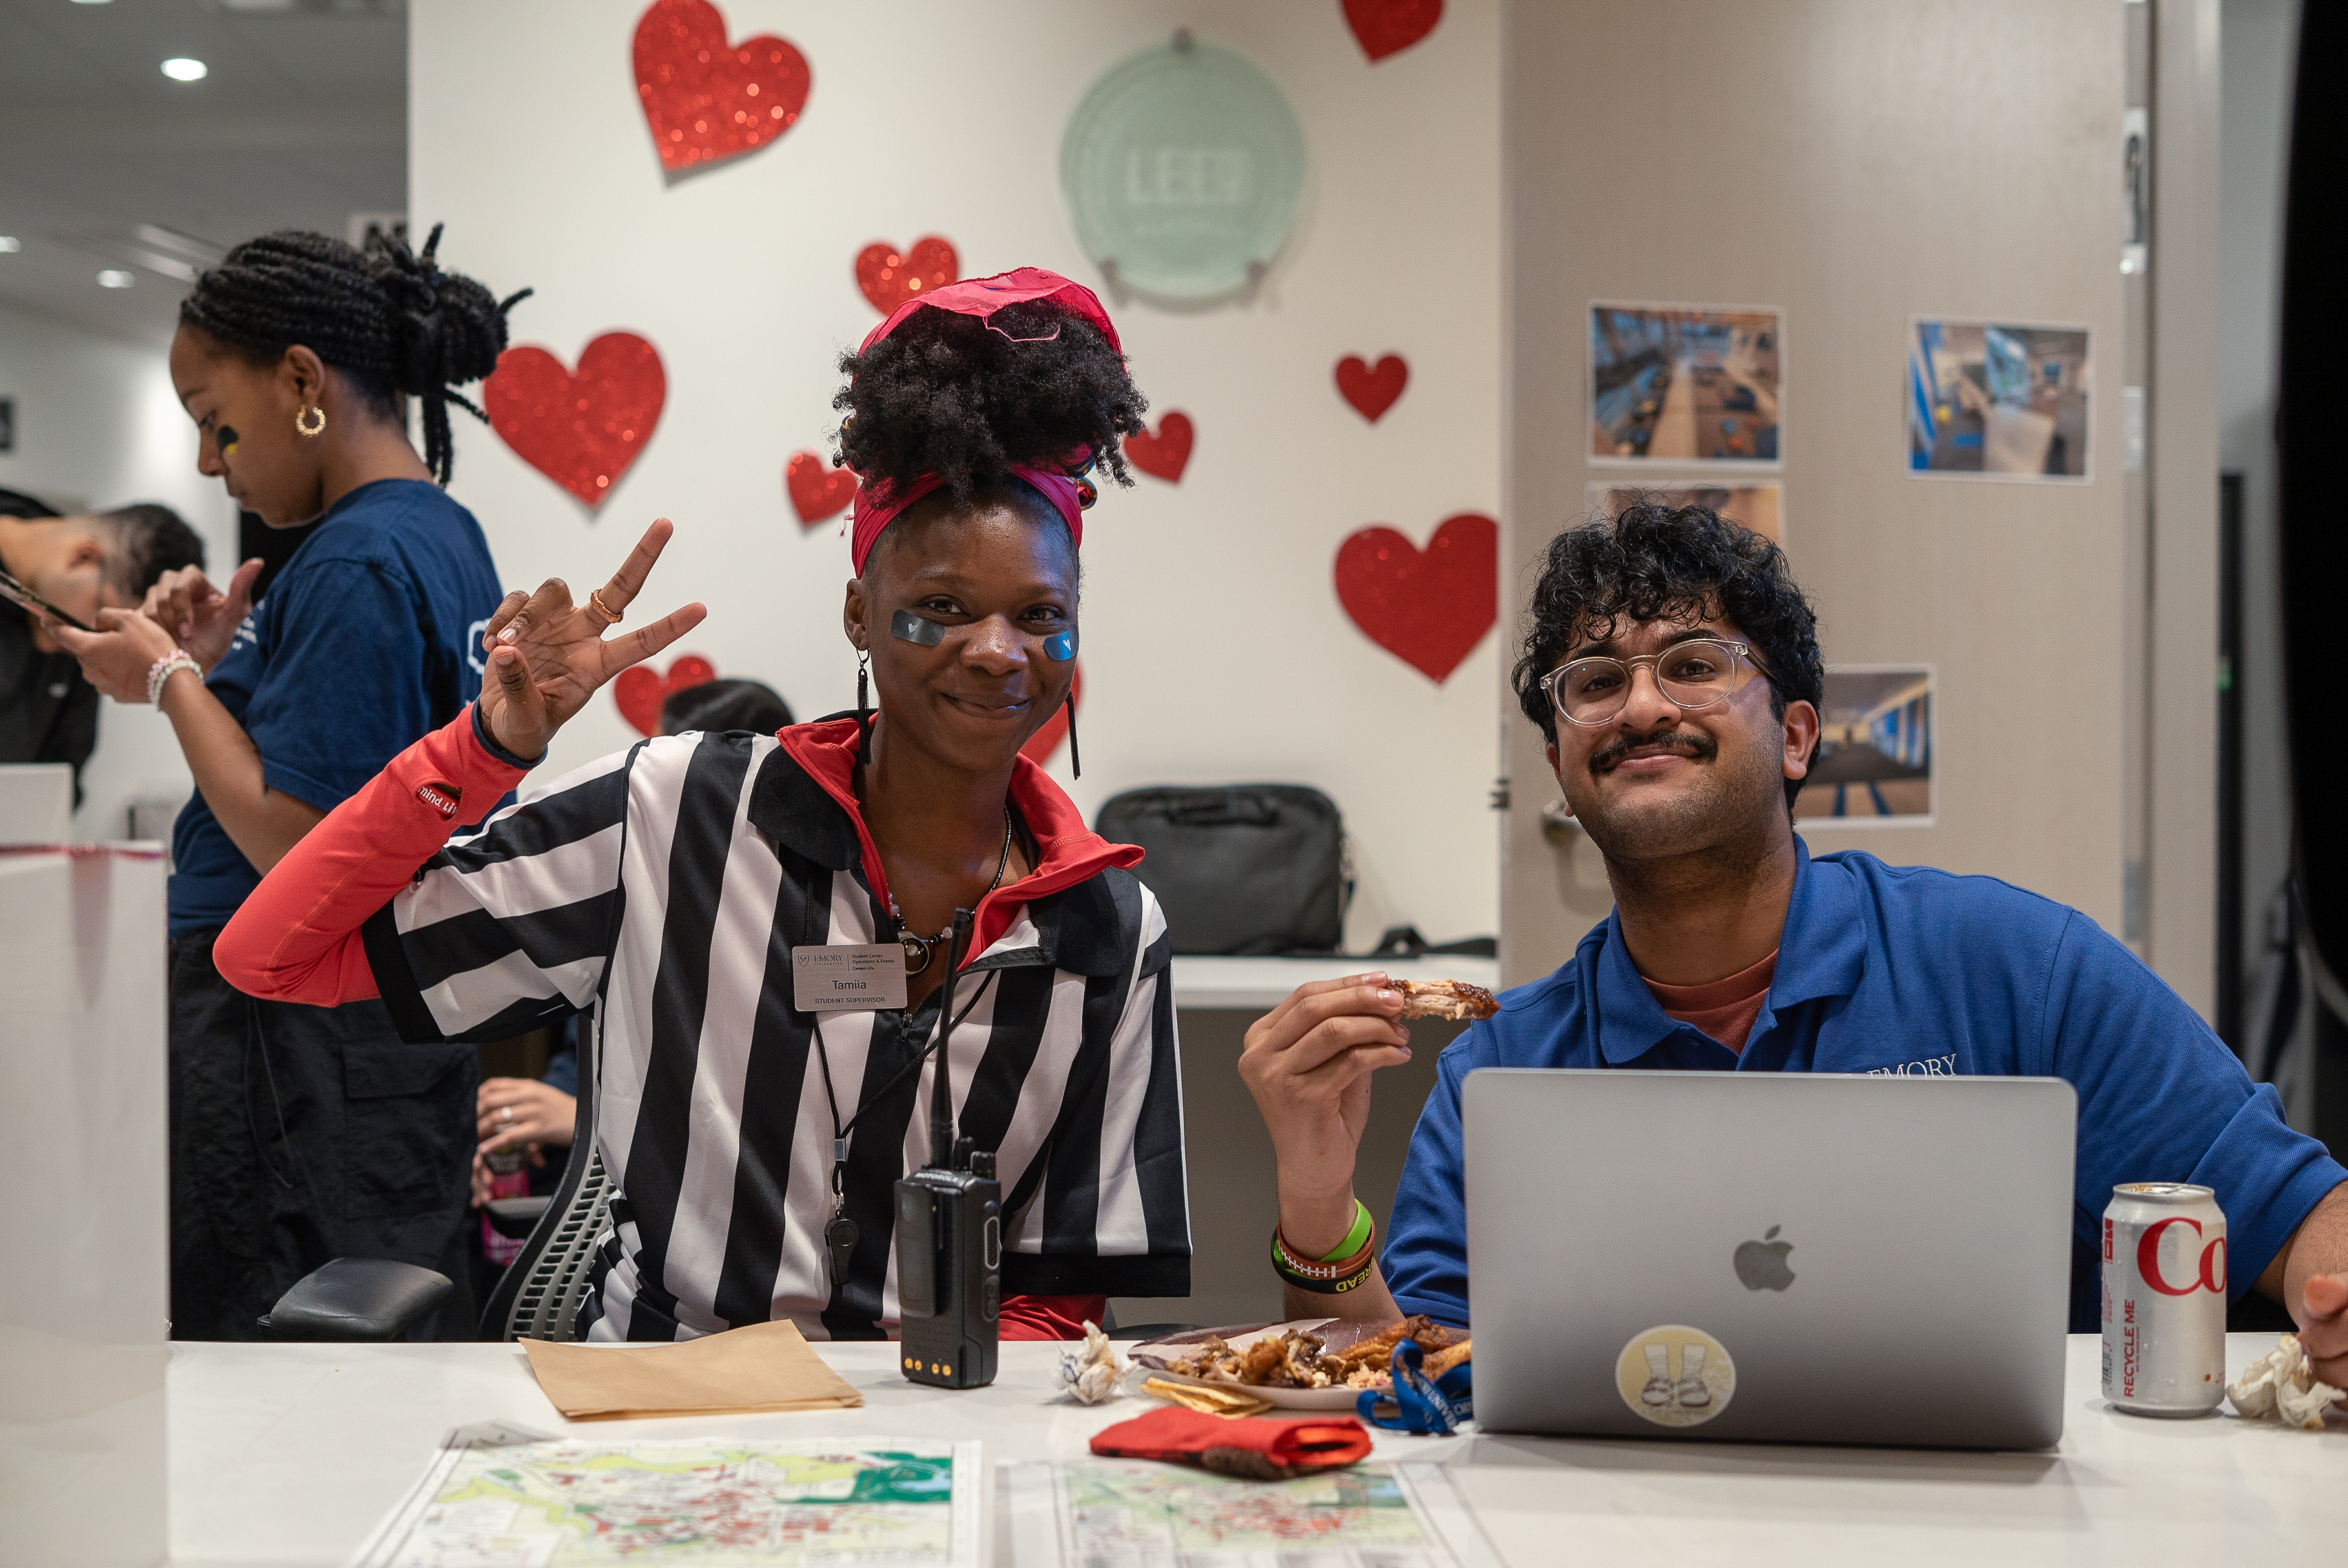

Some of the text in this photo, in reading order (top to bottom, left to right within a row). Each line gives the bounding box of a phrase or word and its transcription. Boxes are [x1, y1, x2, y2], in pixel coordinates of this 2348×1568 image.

[832, 980, 867, 990] Tamiia
[2124, 1299, 2135, 1398] RECYCLE ME
